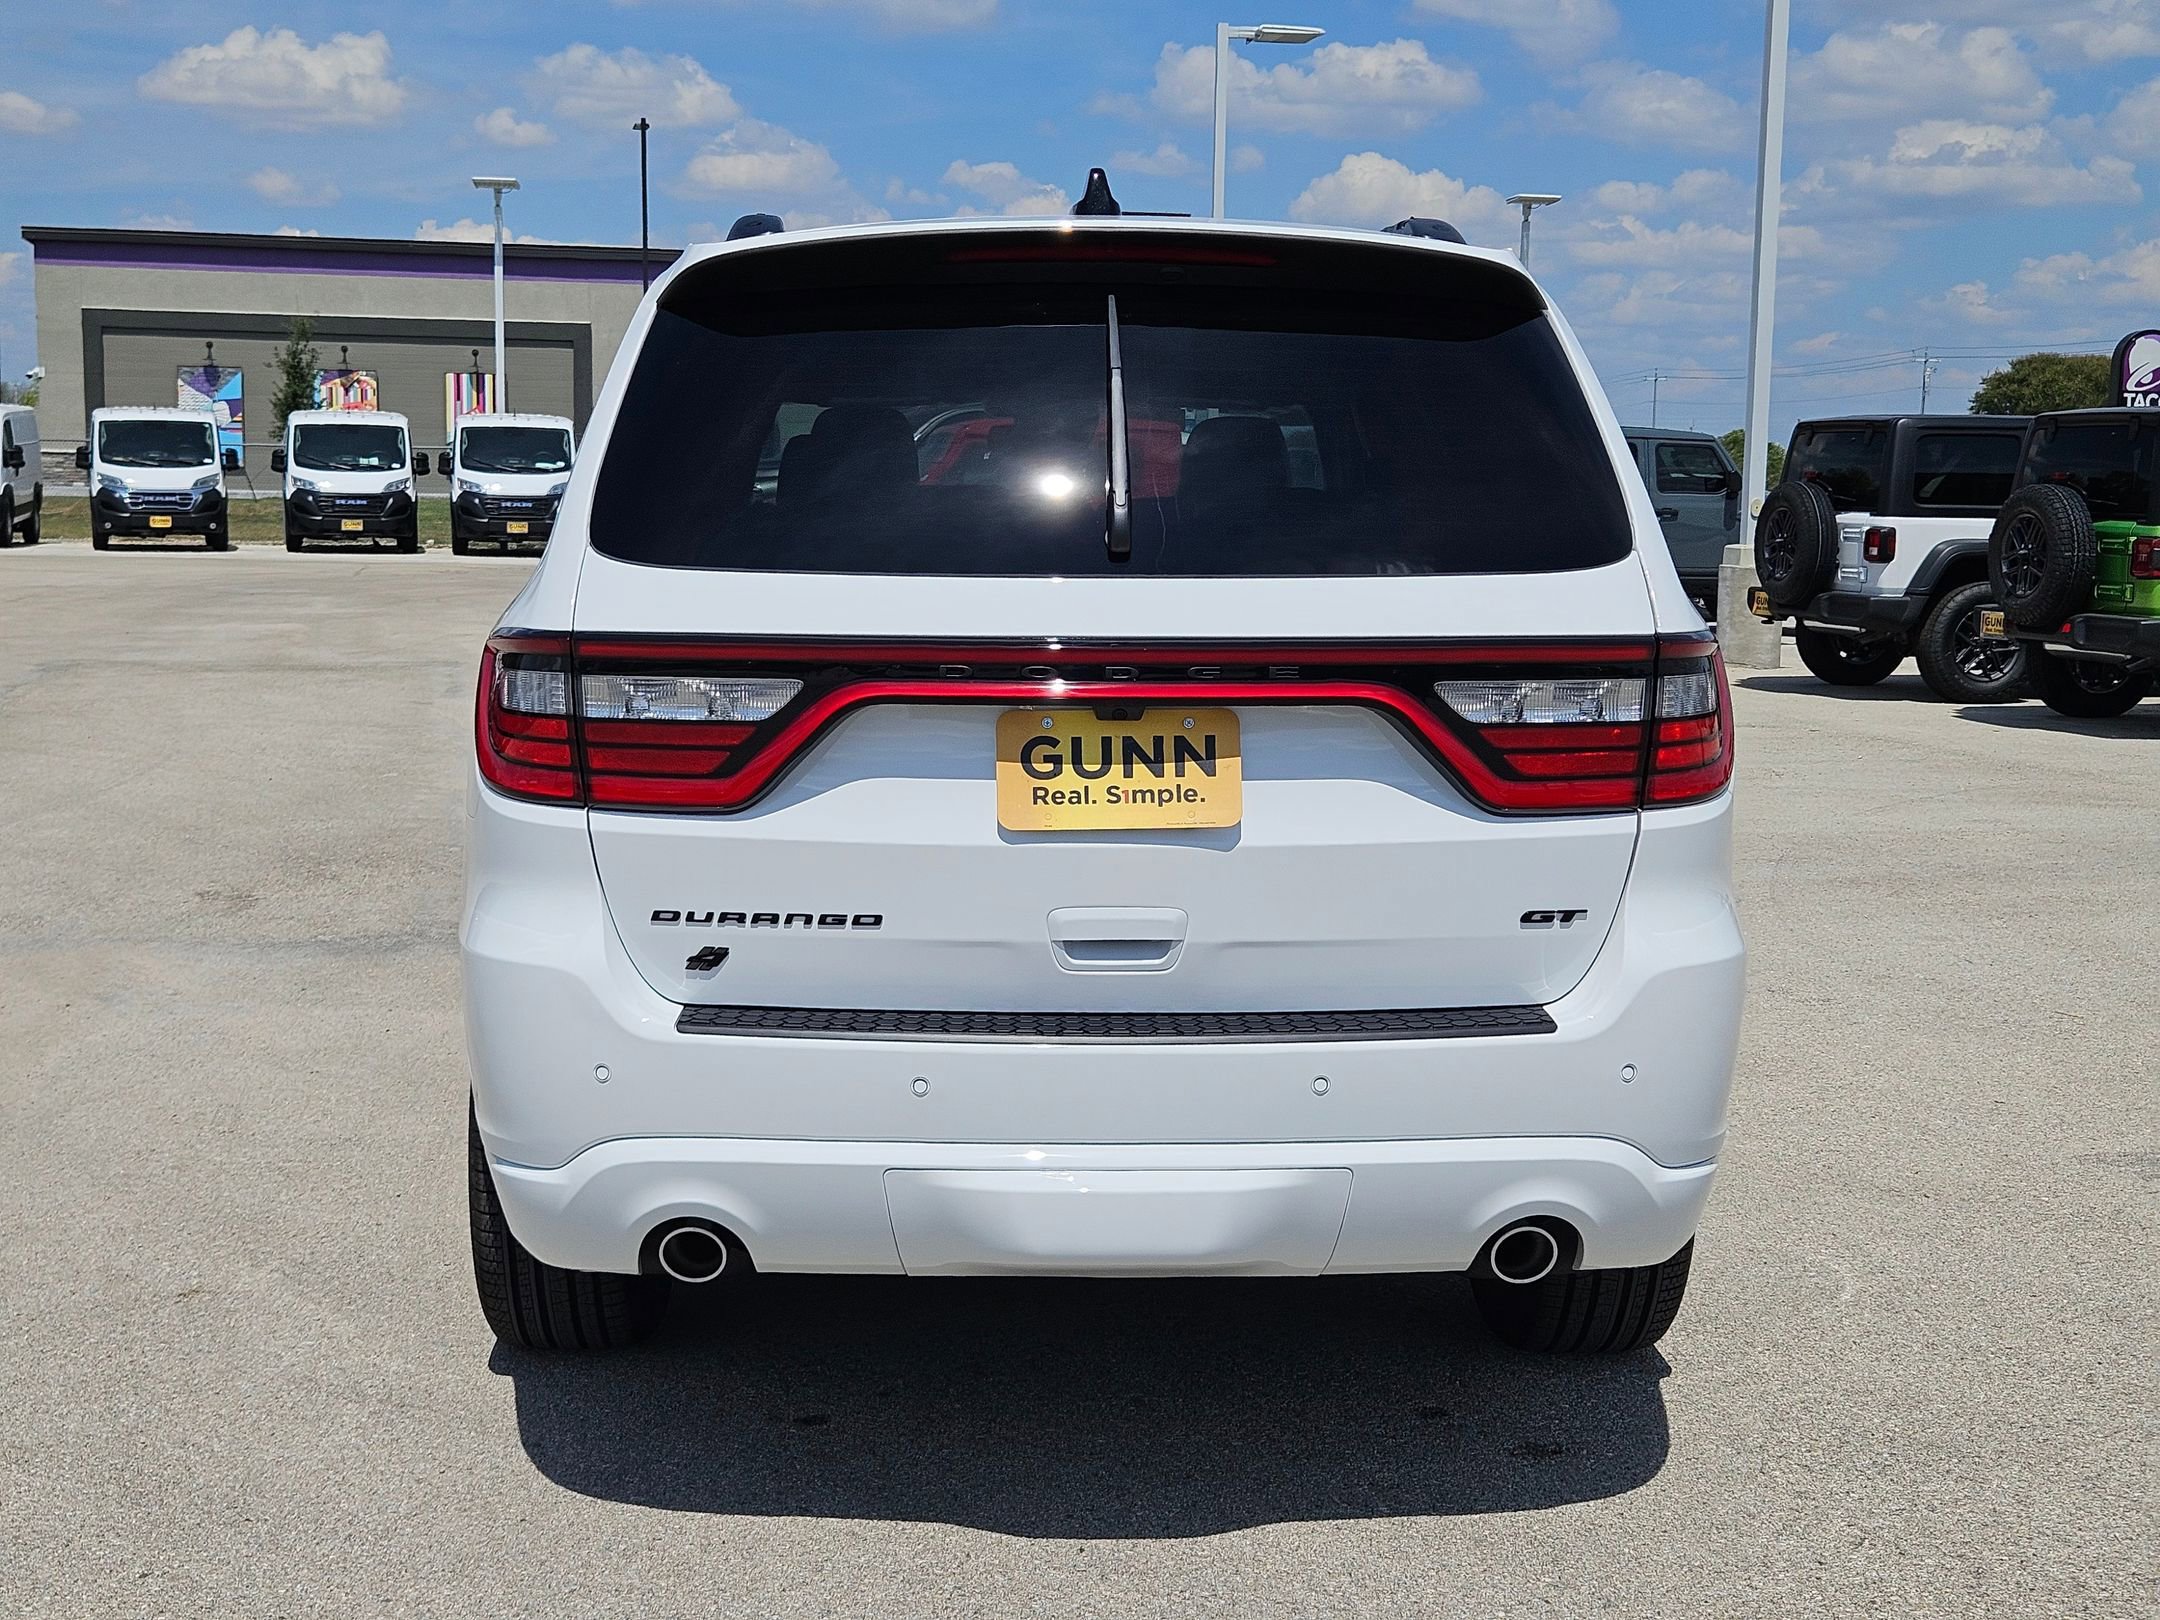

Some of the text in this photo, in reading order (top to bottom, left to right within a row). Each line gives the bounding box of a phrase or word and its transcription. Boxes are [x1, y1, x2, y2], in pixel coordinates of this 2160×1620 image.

[2123, 393, 2160, 407] TAC
[1984, 616, 2003, 627] GUN
[938, 664, 1300, 680] DODGE
[1019, 734, 1217, 780] GUNN
[1032, 785, 1097, 806] Real.
[650, 909, 884, 930] DURANGO
[1519, 909, 1588, 929] GT
